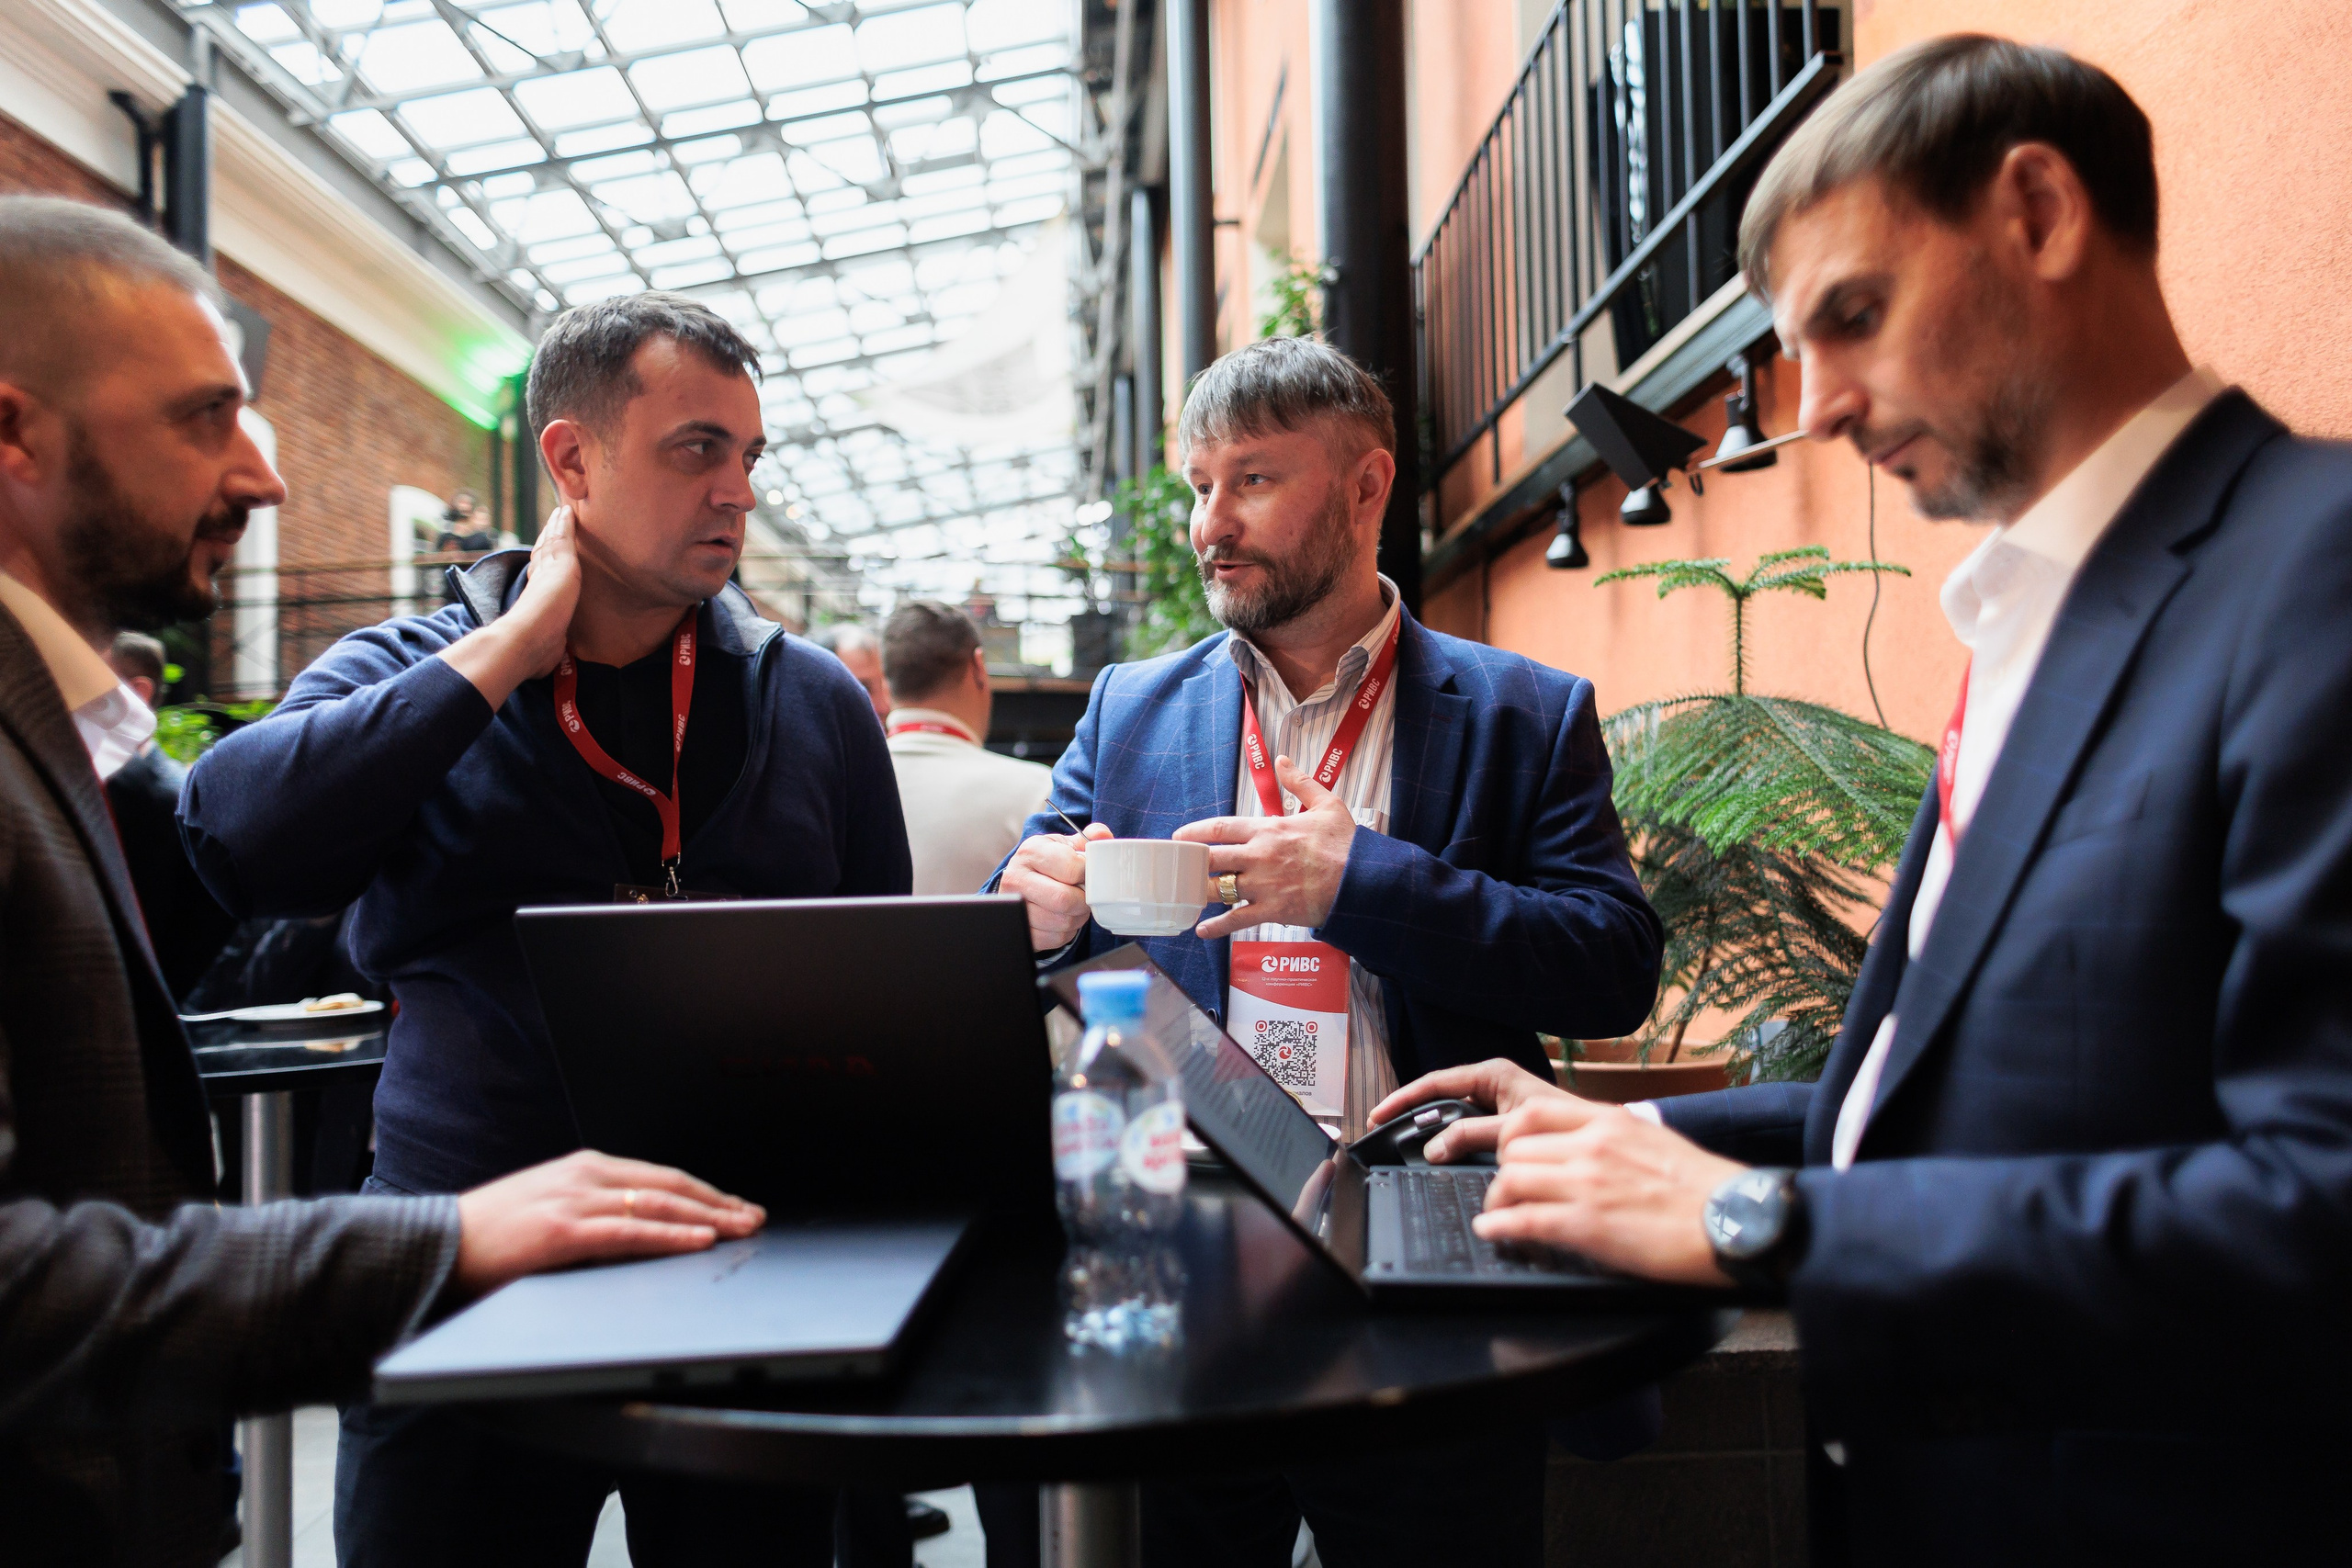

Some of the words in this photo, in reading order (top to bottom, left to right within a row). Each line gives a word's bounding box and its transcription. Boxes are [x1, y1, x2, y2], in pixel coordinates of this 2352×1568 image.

[680, 633, 691, 655] РИВС
[1363, 678, 1381, 701] РИВС
[676, 714, 686, 741] РИВС
[1250, 743, 1265, 770] РИВС
[1324, 748, 1343, 773] РИВС
[616, 772, 644, 790] РИВС
[1279, 956, 1320, 972] РИВС
